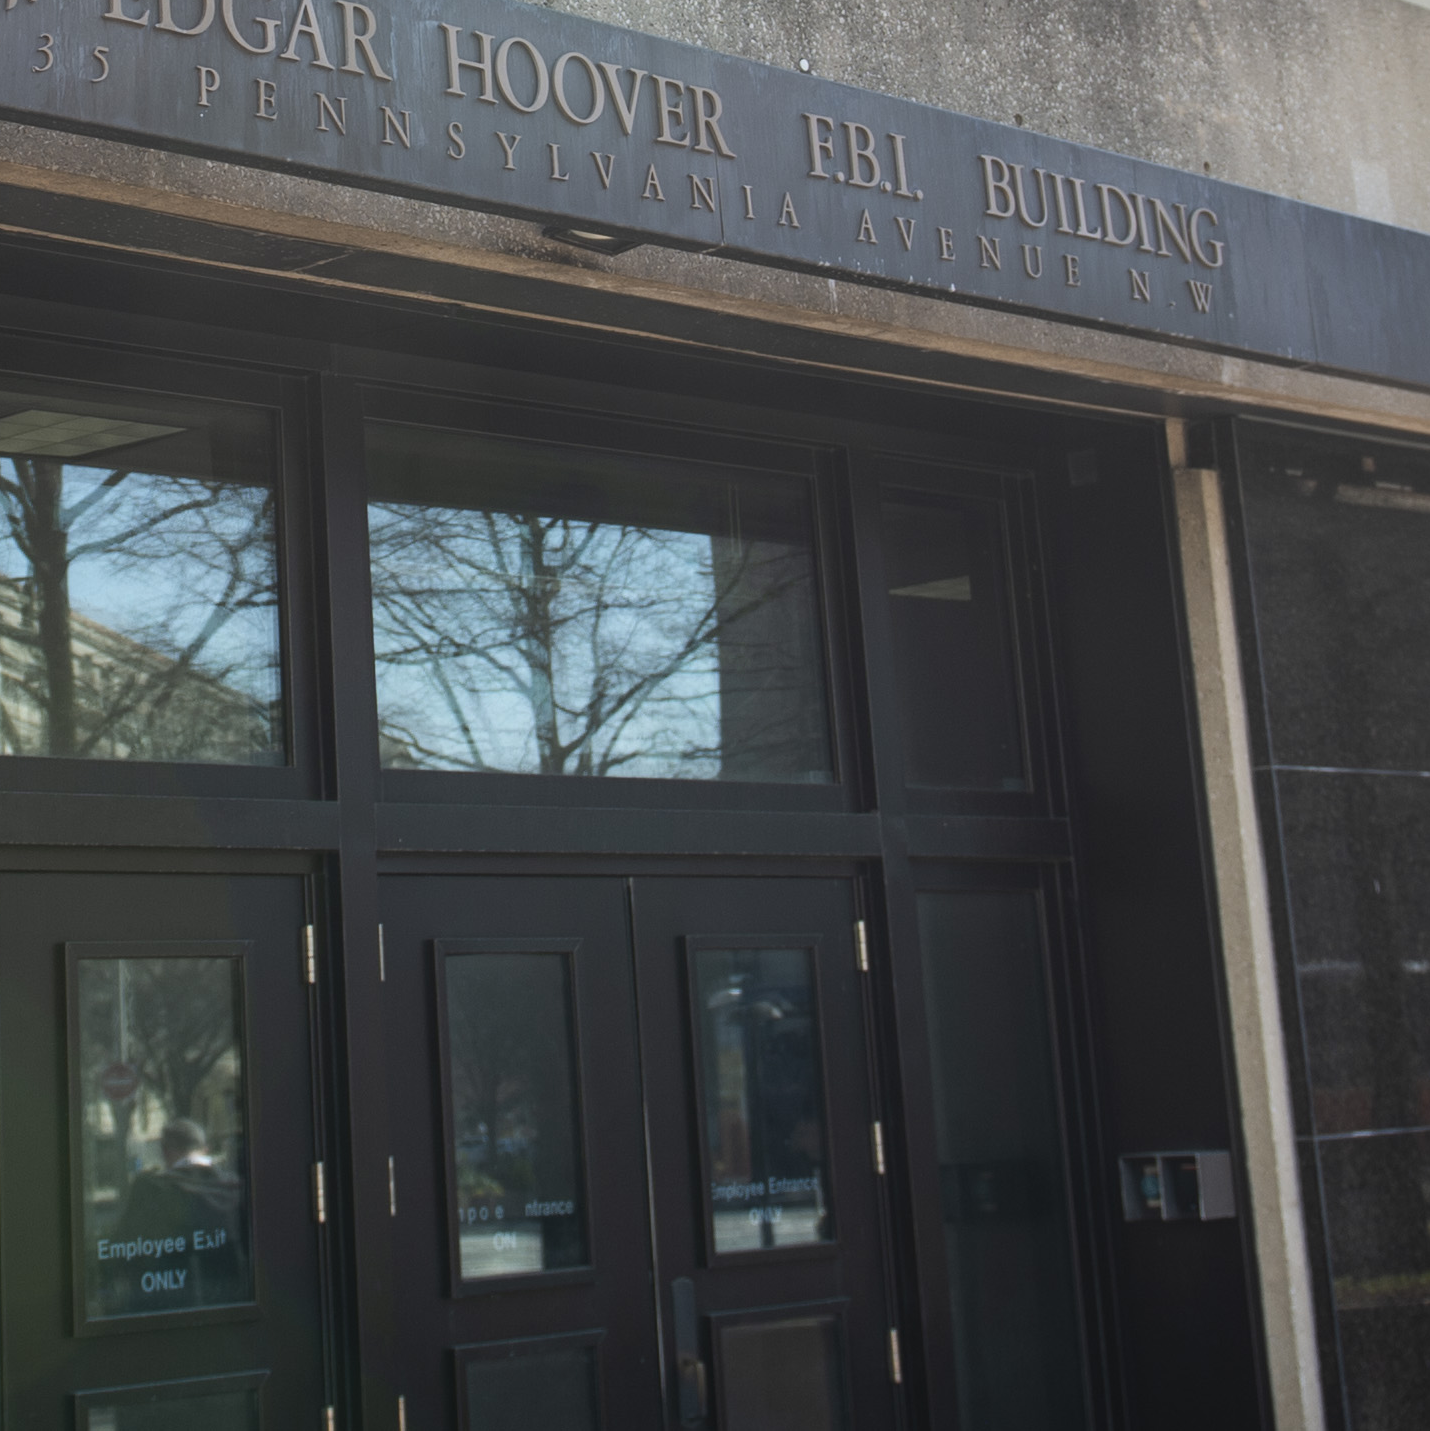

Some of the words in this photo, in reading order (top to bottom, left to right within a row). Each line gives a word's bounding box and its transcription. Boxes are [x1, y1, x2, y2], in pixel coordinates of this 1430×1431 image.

[195, 64, 801, 229] PENNSYLVANIA
[856, 207, 1082, 288] AVENUE
[439, 22, 737, 159] HOOVER
[801, 112, 925, 201] F.B.I.
[977, 153, 1225, 269] BUILDING
[96, 1235, 187, 1261] Employee
[192, 1227, 227, 1251] Exit
[140, 1268, 187, 1293] ONLY
